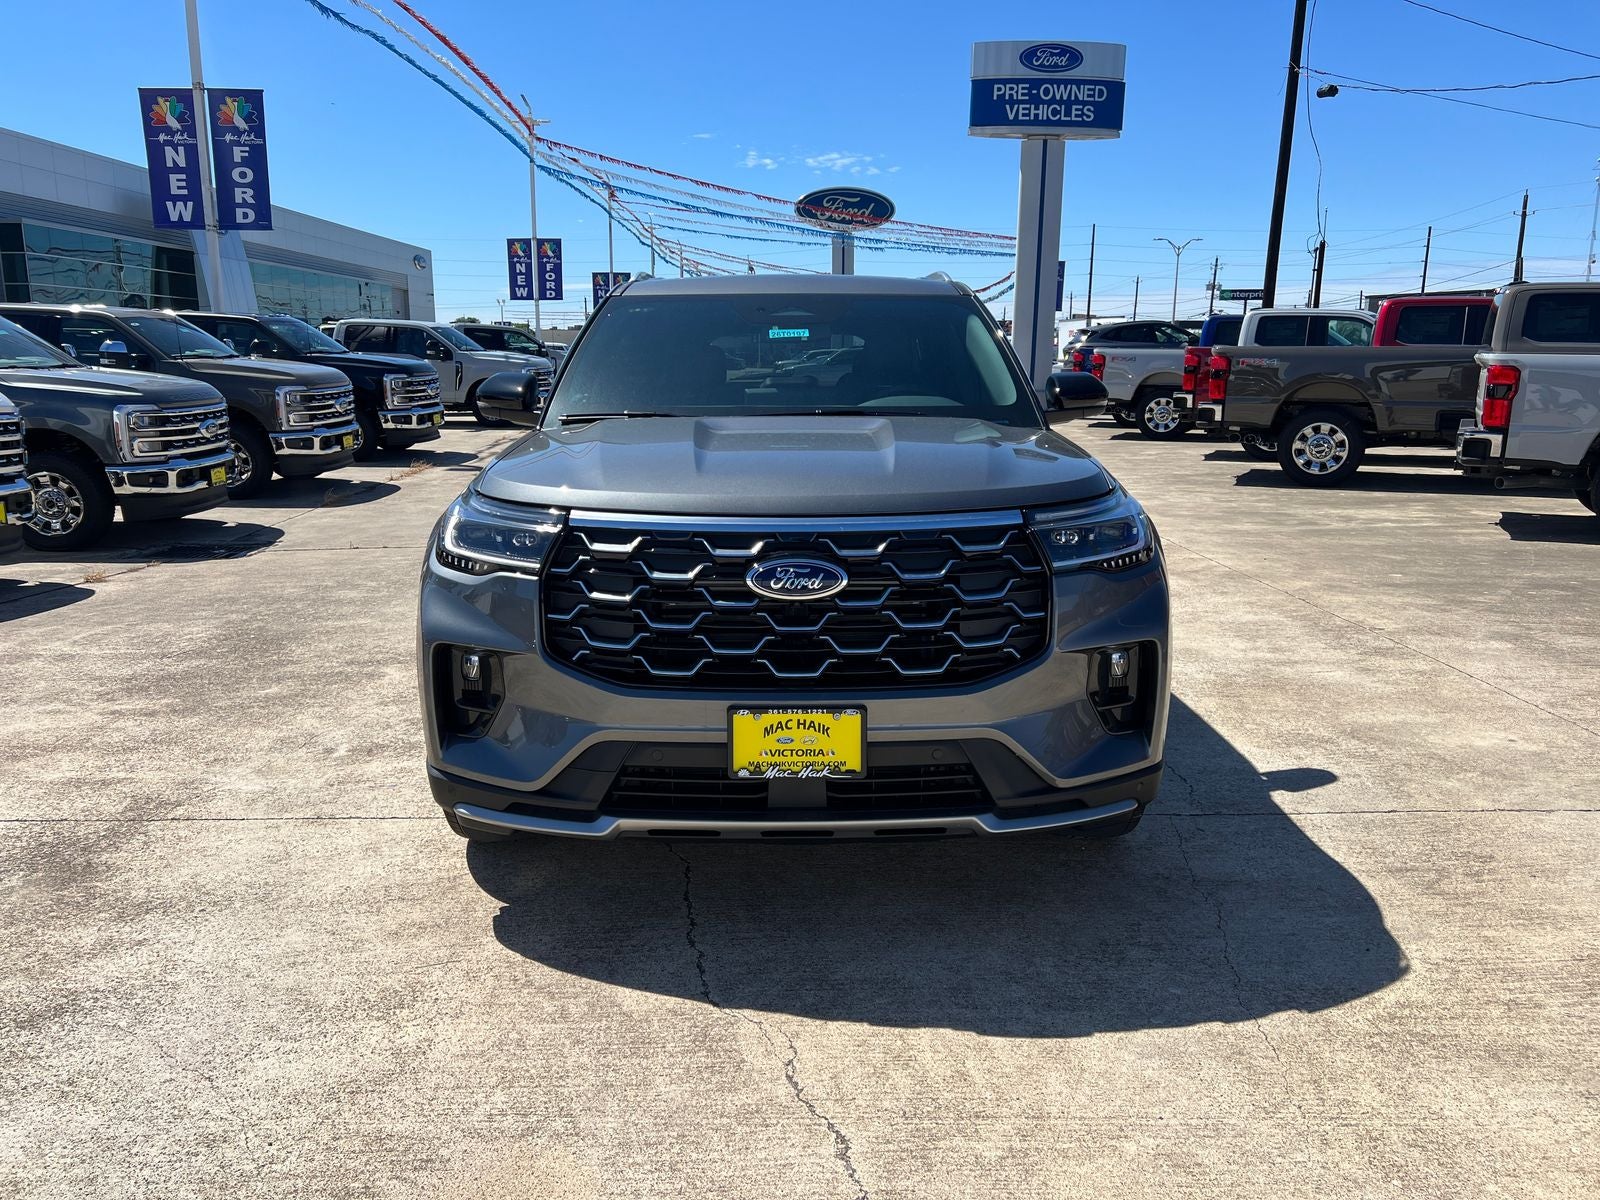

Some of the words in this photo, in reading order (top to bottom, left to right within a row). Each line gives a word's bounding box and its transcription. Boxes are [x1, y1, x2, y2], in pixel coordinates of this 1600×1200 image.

[1032, 48, 1070, 66] Ford
[993, 84, 1108, 101] PRE-OWNED
[1005, 104, 1095, 121] VEHICLES
[164, 146, 194, 222] NEW
[231, 146, 256, 224] FORD
[816, 195, 875, 221] Ford
[515, 263, 528, 298] NEW
[545, 263, 556, 298] FORD
[770, 567, 825, 590] Ford
[763, 719, 793, 739] MAC
[796, 719, 831, 738] HAIK
[769, 749, 826, 758] VICTORIA
[747, 761, 847, 769] MACHAIKVICTORIA.COM
[763, 766, 792, 779] Mac
[797, 766, 832, 779] Haik
